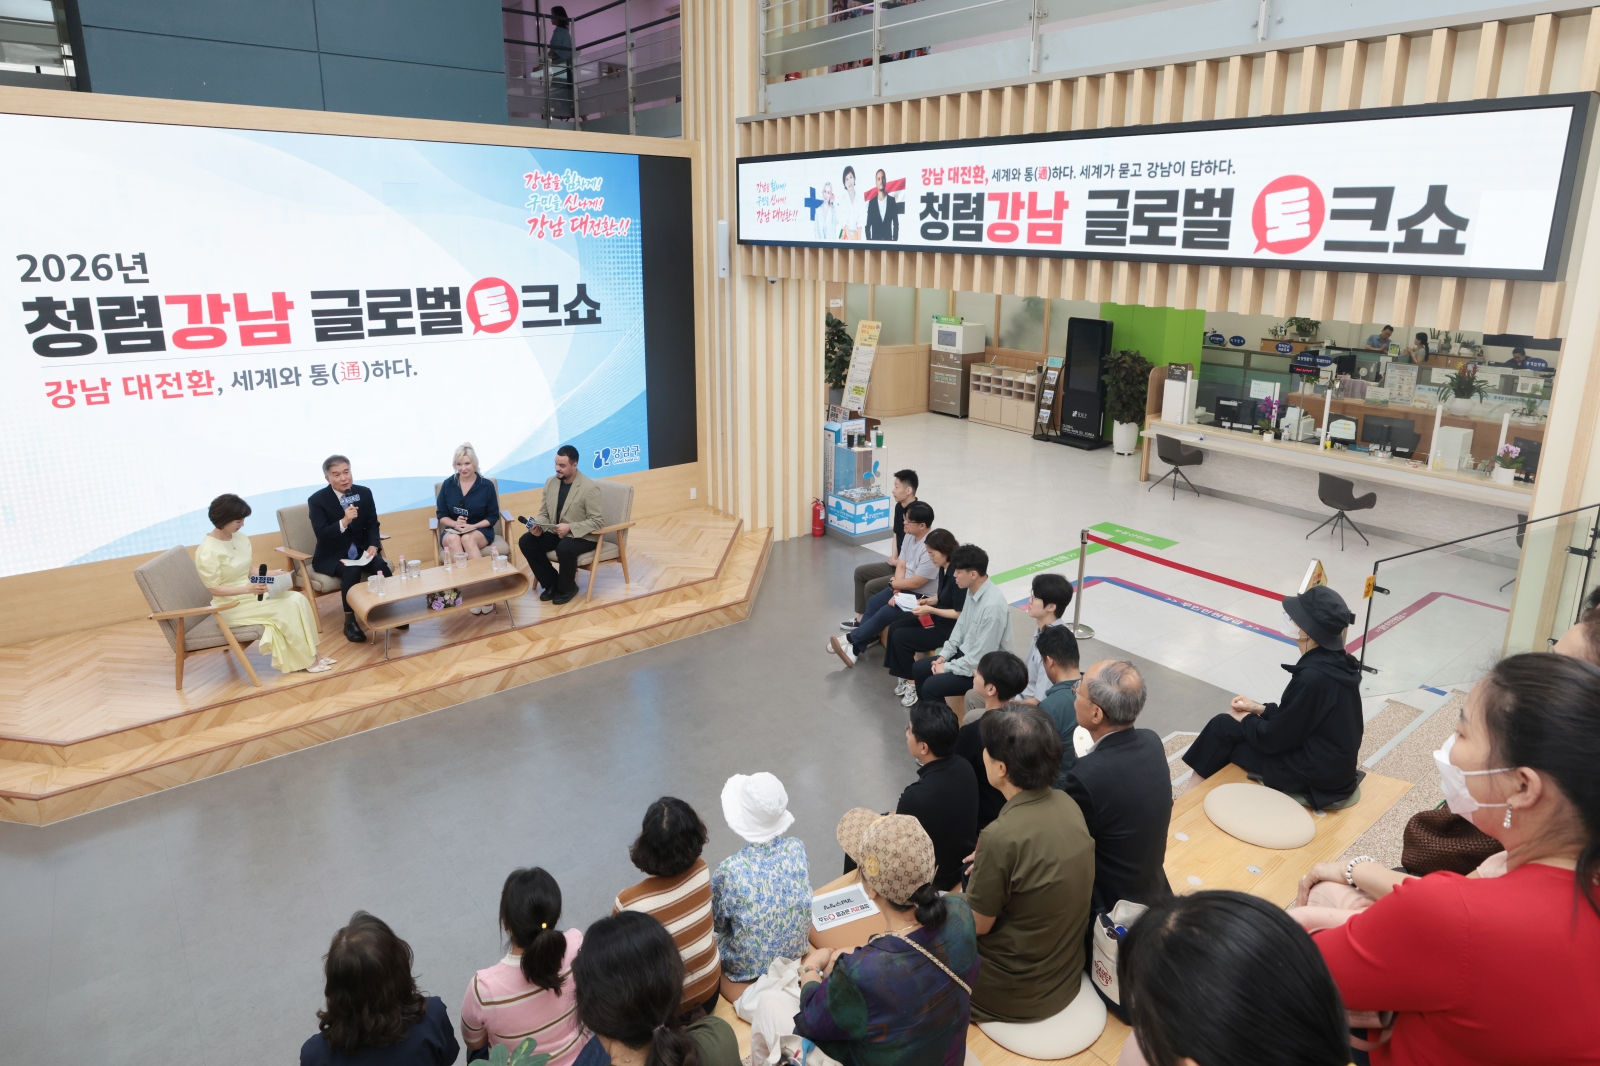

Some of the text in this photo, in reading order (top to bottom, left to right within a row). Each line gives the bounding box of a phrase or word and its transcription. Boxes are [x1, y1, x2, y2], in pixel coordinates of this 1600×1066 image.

[524, 168, 602, 191] 강남을 힘차게!
[922, 159, 1236, 186] 강남 대전환, 세계와 통(通)하다. 세계가 묻고 강남이 답하다.
[526, 194, 604, 212] 구민을 신나게!
[527, 213, 630, 239] 강남 대전환!!
[919, 191, 1069, 245] 청렴강남
[1085, 187, 1234, 250] 글로벌
[16, 252, 150, 284] 2026년
[22, 291, 295, 358] 청렴강남
[310, 286, 463, 342] 글로벌
[45, 358, 418, 409] 강남 대전환, 세계와 통(通)하다.
[612, 445, 640, 459] 강남구
